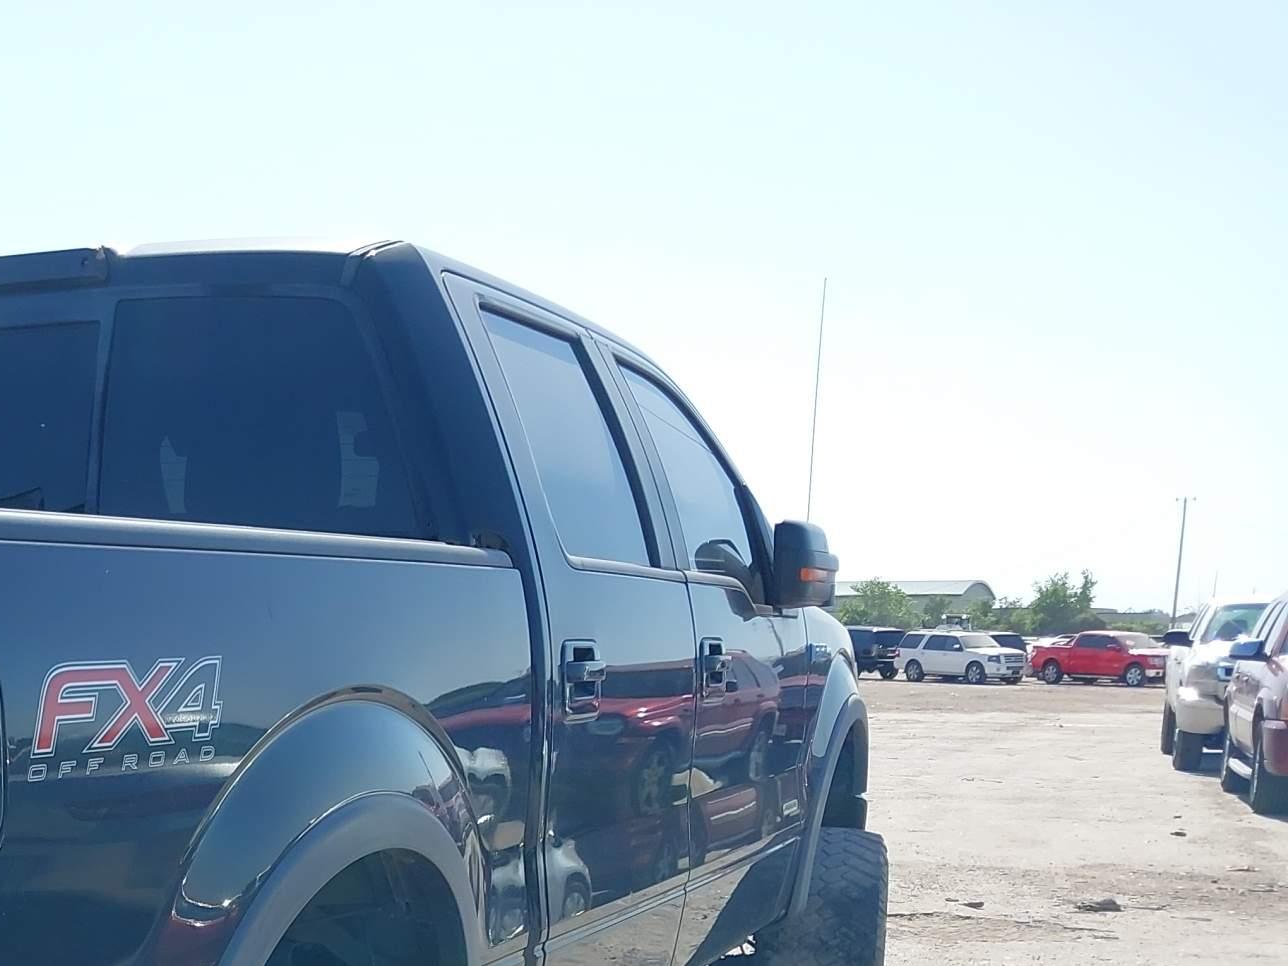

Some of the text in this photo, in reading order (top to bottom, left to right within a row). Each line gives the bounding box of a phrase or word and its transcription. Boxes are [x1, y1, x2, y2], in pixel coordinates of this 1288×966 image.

[30, 655, 223, 759] FX4
[26, 745, 216, 783] OFF ROAD
